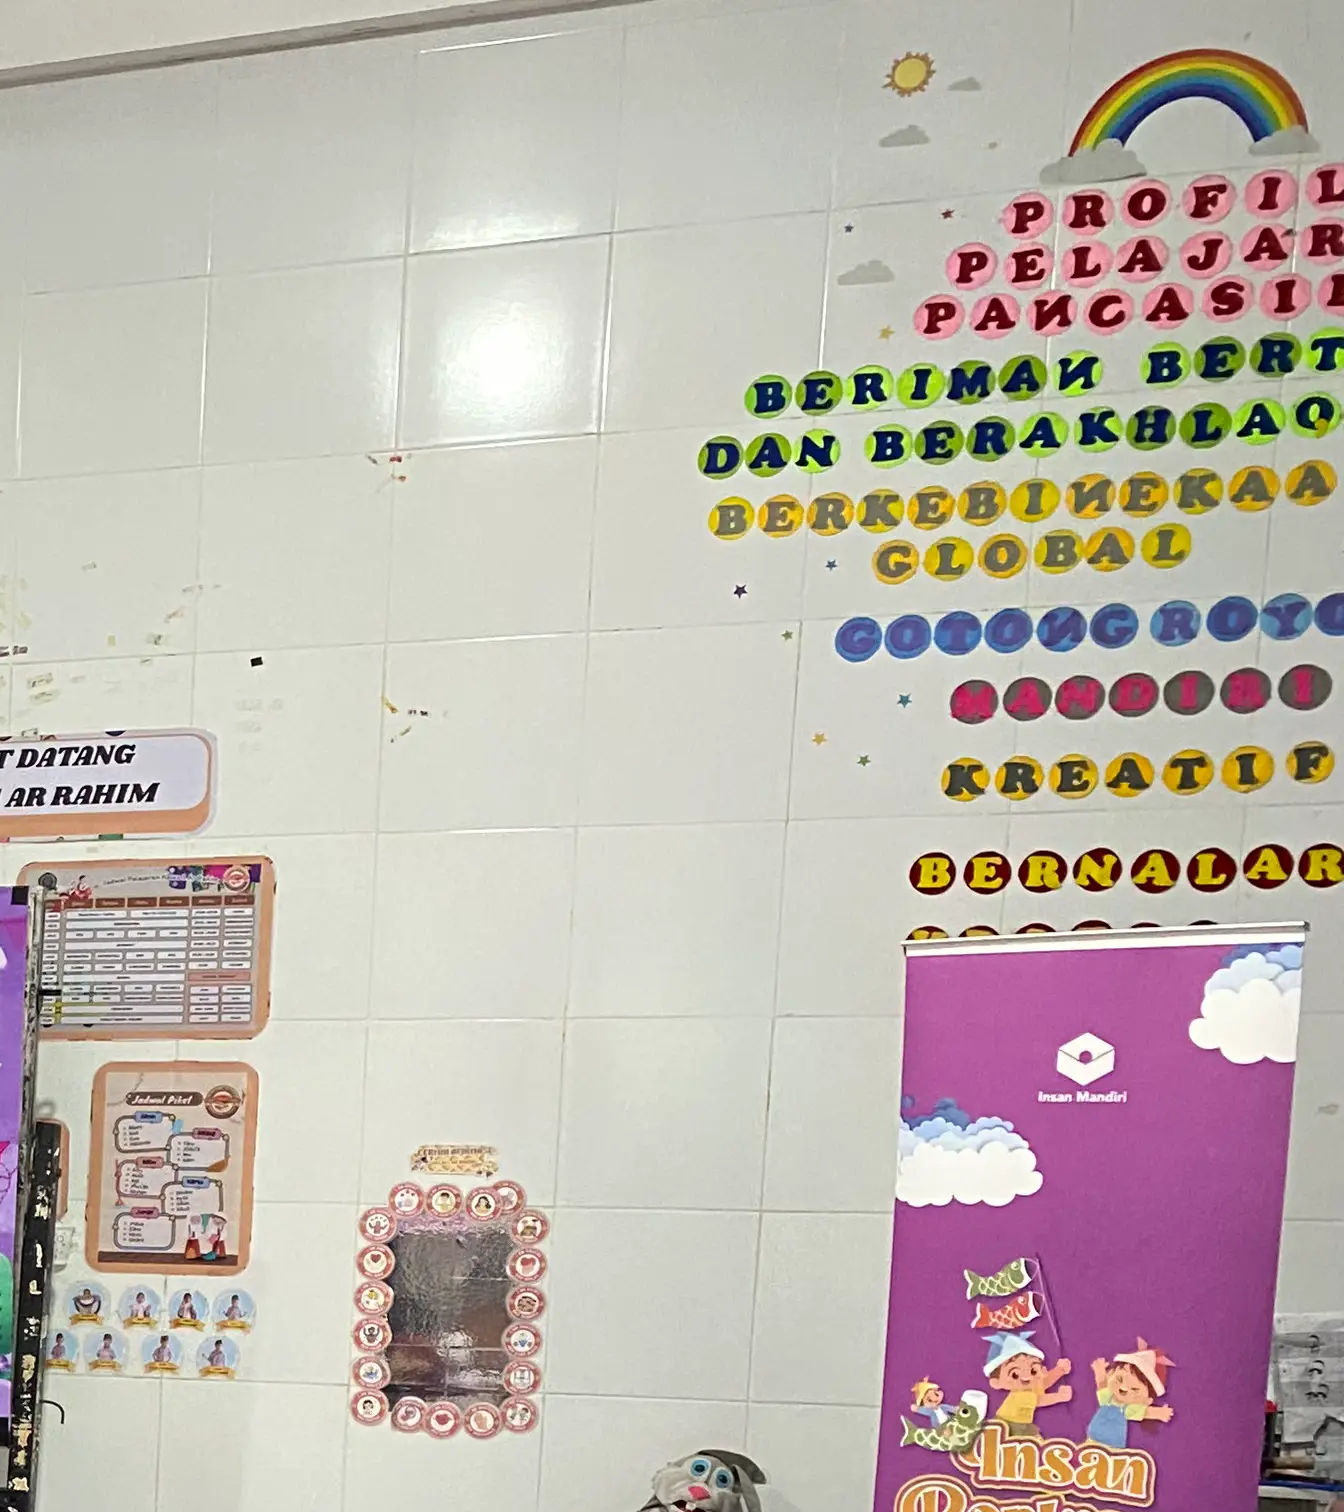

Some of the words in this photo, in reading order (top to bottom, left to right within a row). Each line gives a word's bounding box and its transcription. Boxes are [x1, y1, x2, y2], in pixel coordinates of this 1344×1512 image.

[1012, 169, 1344, 234] PROFIL
[954, 223, 1344, 283] PELAJAR
[752, 354, 1100, 416] BERIMAN
[701, 434, 837, 473] DAN
[869, 396, 1334, 463] BERAKHLAQ
[879, 529, 1187, 578] GLOBAL
[840, 608, 1135, 658] GOTONG
[950, 669, 1314, 720] MANDIRI
[16, 744, 137, 769] DATANG
[944, 746, 1329, 797] KREATIF
[6, 786, 47, 809] AR
[50, 782, 161, 807] RAHIM
[916, 847, 1344, 891] BERNALAR
[960, 1424, 1150, 1501] Insan
